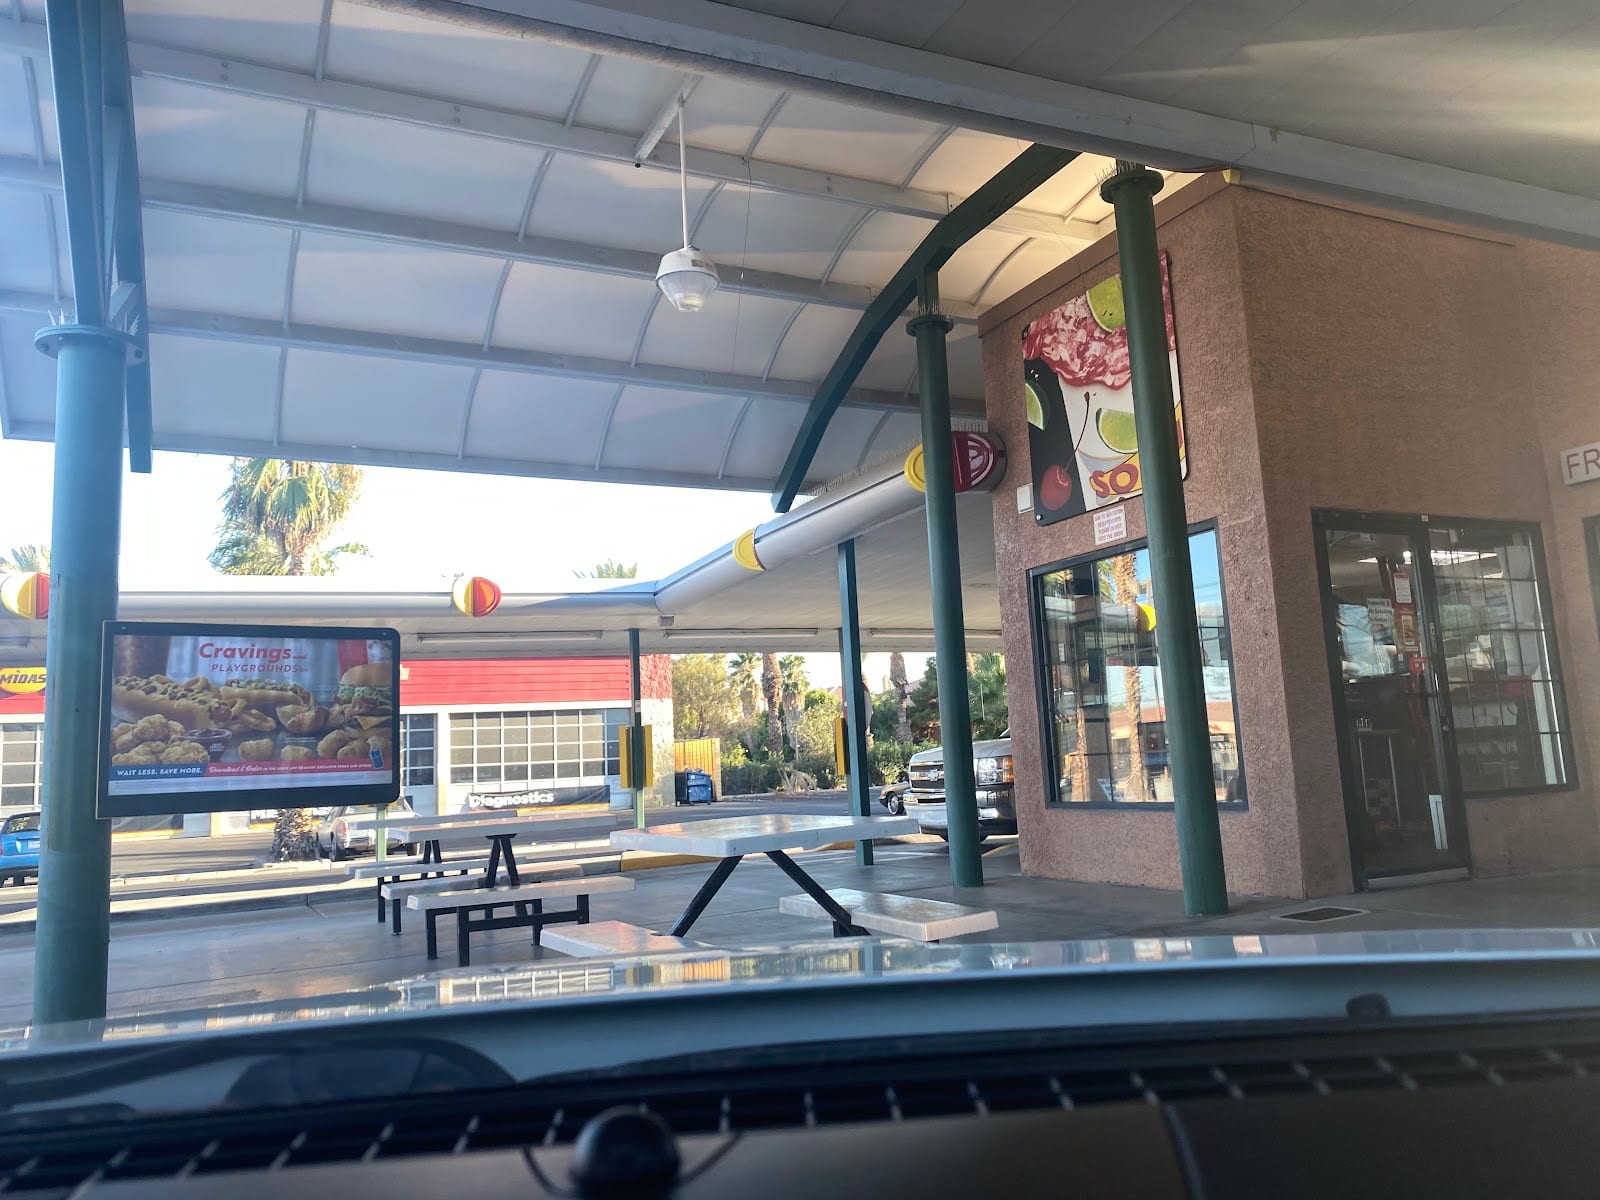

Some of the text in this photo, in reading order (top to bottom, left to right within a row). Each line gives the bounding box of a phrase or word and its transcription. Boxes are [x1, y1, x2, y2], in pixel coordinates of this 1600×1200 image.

[199, 642, 292, 663] Cravings
[211, 663, 299, 673] PLAYGROUNDS
[0, 669, 47, 684] MIDAS
[160, 767, 178, 775] SAVE
